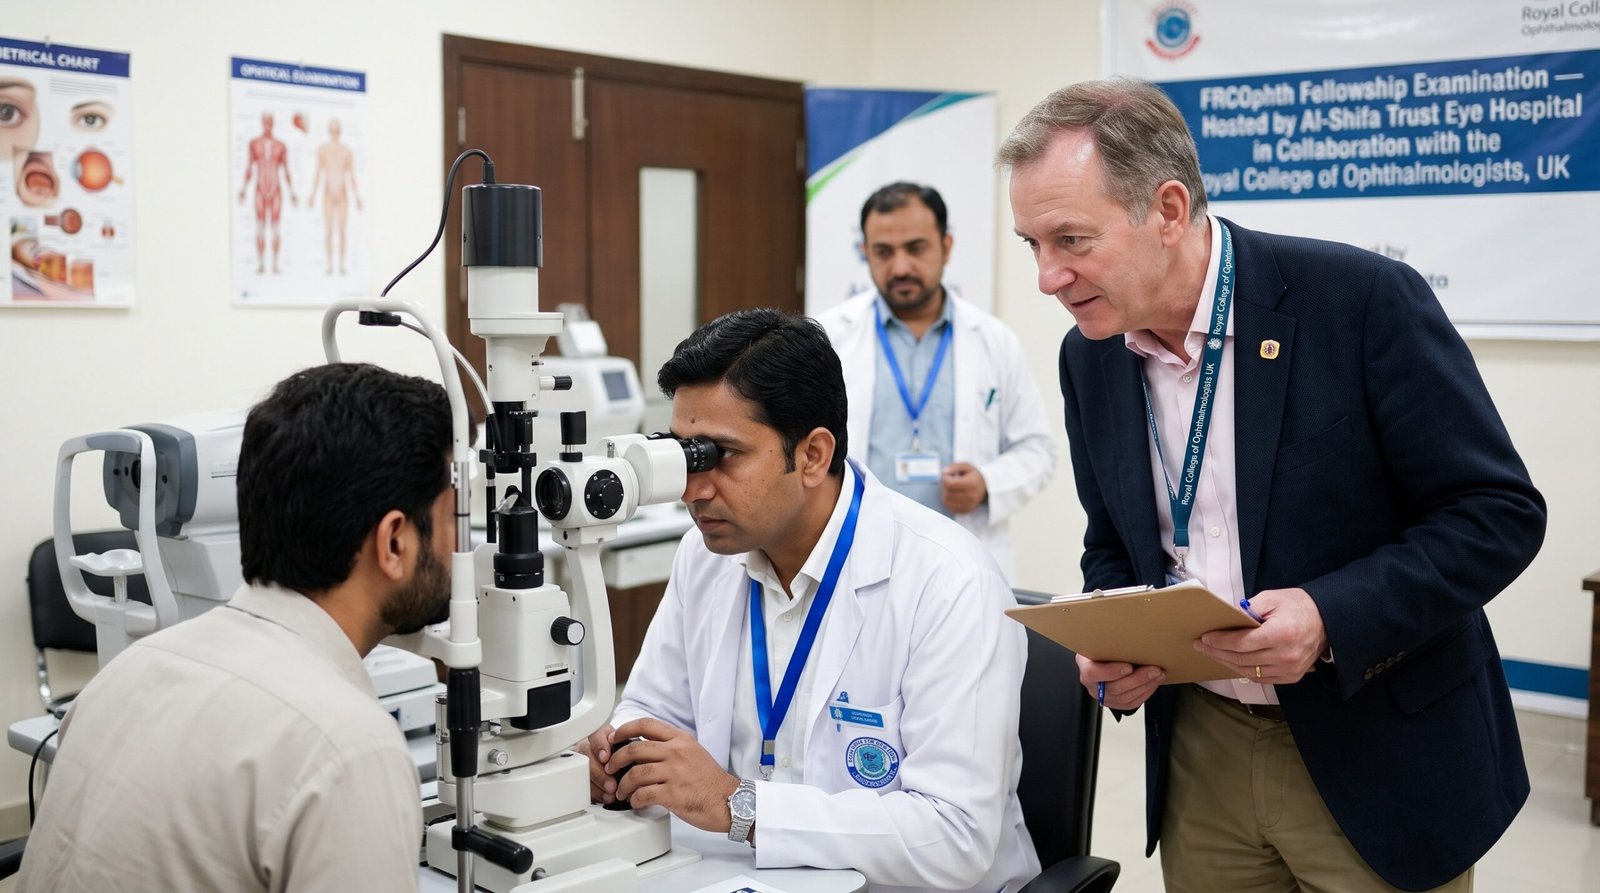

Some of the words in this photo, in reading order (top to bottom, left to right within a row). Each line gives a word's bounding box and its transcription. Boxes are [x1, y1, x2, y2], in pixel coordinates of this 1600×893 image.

[1522, 3, 1564, 23] Royal
[1568, 0, 1600, 17] Coll
[57, 53, 100, 70] CHART
[1200, 83, 1295, 111] FRCOphth
[1300, 75, 1408, 105] Fellowship
[1413, 66, 1548, 97] Examination
[1202, 111, 1269, 138] Hosted
[1273, 111, 1297, 138] by
[1300, 105, 1381, 133] Al-Shifa
[1386, 102, 1439, 128] Trust
[1445, 100, 1483, 128] Eye
[1490, 93, 1583, 124] Hospital
[1253, 140, 1272, 163] in
[1276, 131, 1410, 163] Collaboration
[1416, 130, 1460, 156] with
[1467, 129, 1501, 153] the
[1204, 167, 1239, 197] oyal
[1243, 165, 1314, 194] College
[1318, 164, 1339, 189] of
[1343, 157, 1530, 192] Ophthalmologists,
[1537, 154, 1570, 181] UK
[1223, 275, 1230, 284] of
[1217, 285, 1230, 312] College
[1213, 313, 1224, 335] Royal
[1205, 363, 1215, 375] UK
[1193, 376, 1213, 444] Ophthalmologists
[1191, 444, 1199, 454] of
[1185, 455, 1199, 482] College
[1181, 481, 1193, 505] Royal
